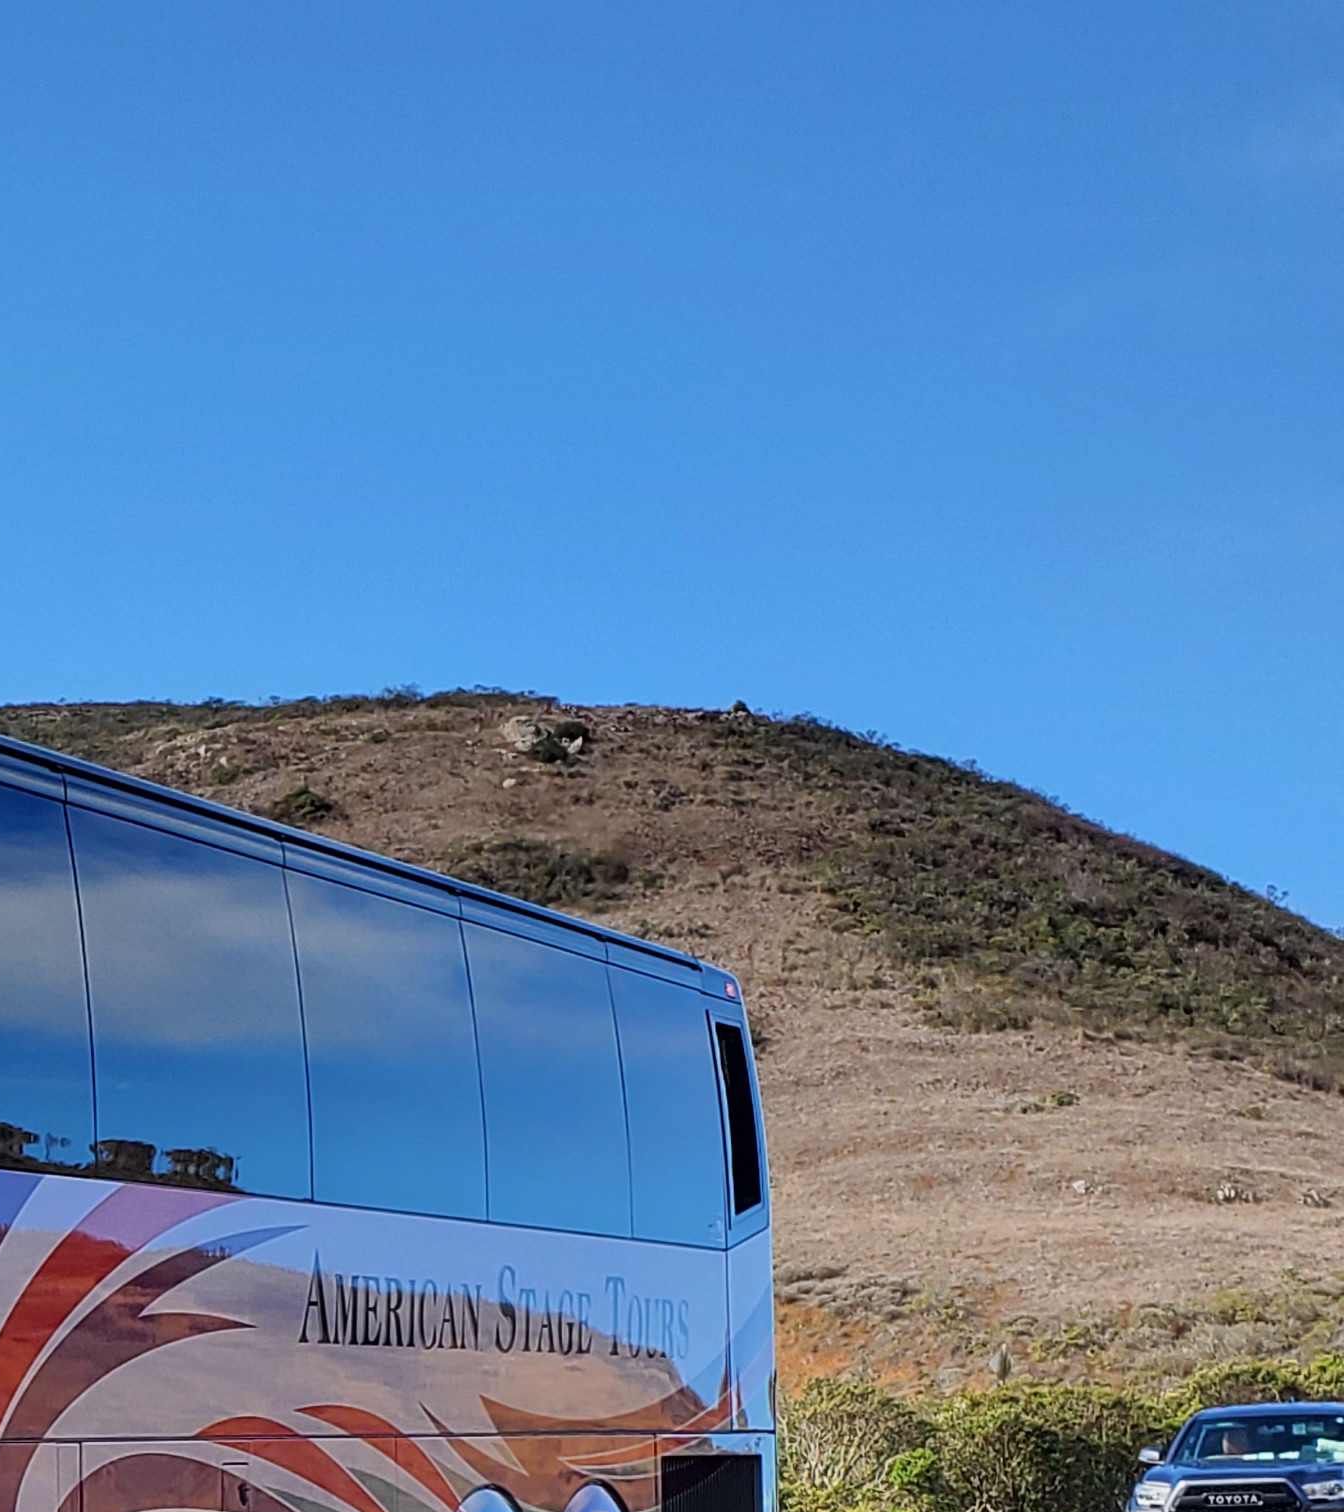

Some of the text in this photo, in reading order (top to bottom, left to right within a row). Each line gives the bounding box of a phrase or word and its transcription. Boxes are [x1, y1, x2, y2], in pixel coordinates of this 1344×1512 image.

[298, 1248, 690, 1360] AMERICAN STAGE TOURS
[1208, 1495, 1258, 1504] TOYOTA
